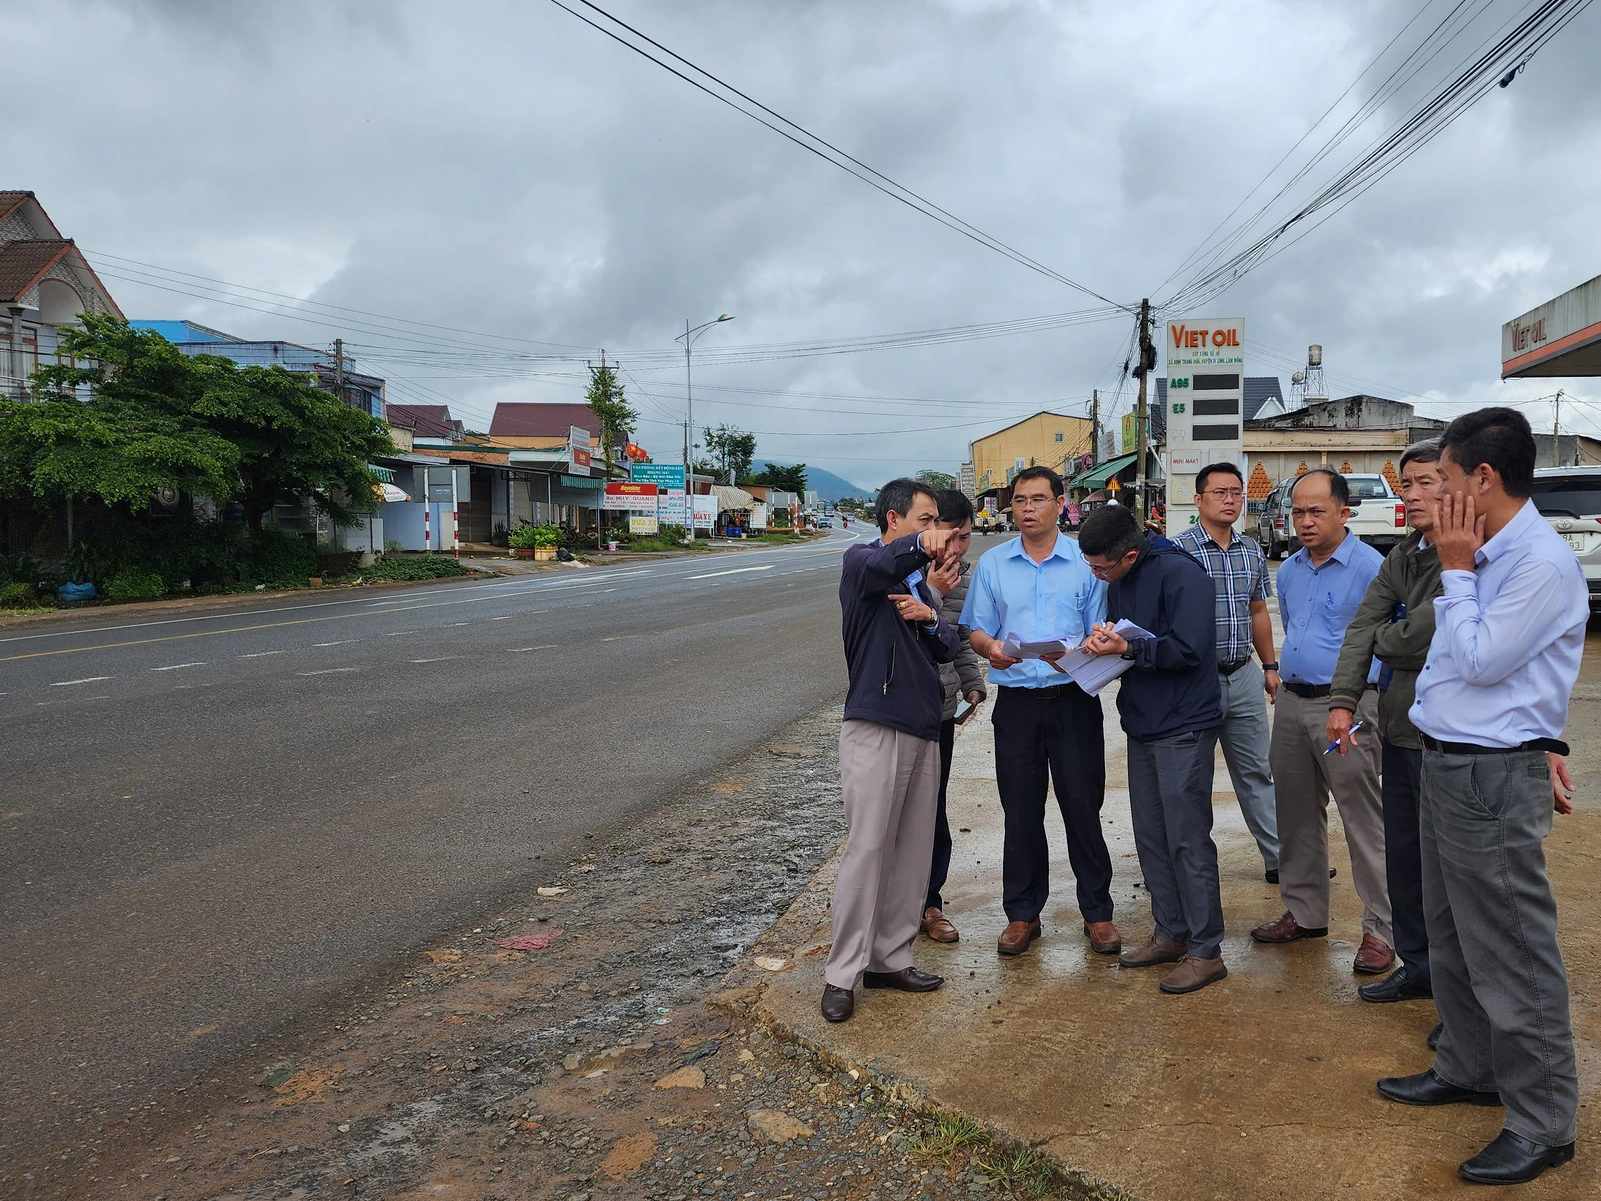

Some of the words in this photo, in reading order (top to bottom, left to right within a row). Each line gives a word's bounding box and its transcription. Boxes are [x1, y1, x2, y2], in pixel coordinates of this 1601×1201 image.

[1171, 325, 1209, 348] VIET
[1212, 329, 1240, 347] OIL
[1511, 322, 1530, 352] VIET
[1530, 317, 1547, 343] OIL
[1170, 378, 1189, 388] A95
[1172, 403, 1185, 414] E5
